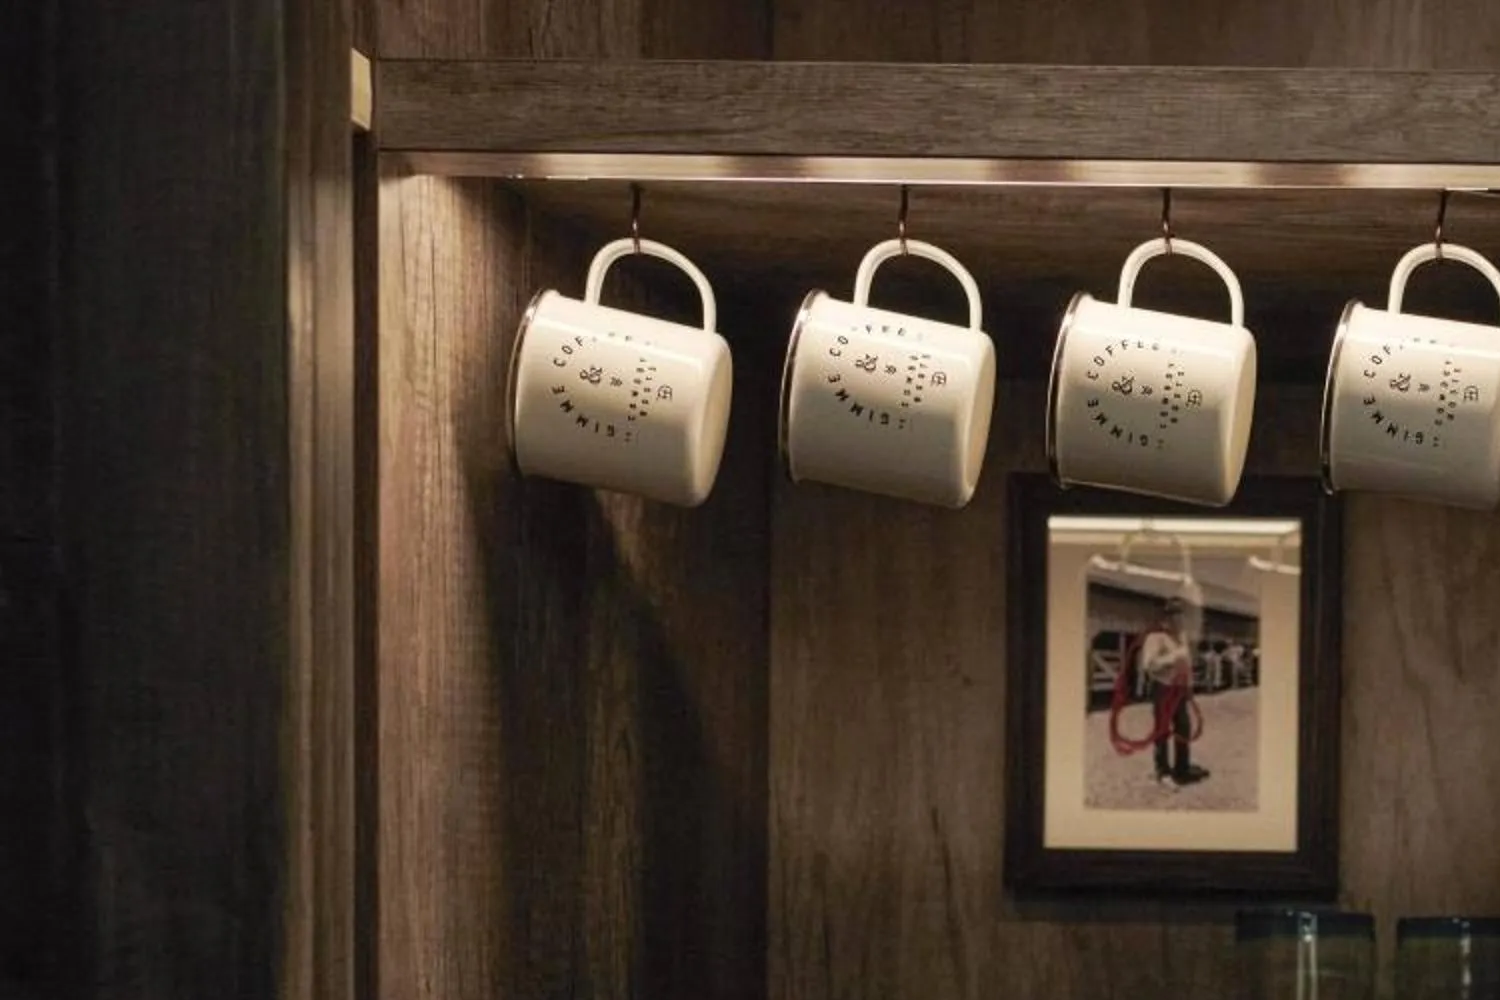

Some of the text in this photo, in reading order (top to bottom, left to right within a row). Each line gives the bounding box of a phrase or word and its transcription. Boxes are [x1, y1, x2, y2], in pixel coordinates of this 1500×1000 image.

[552, 384, 615, 437] GIMME
[827, 373, 889, 425] GIMME
[1087, 398, 1148, 447] GIMME
[1363, 395, 1424, 445] GIMME
